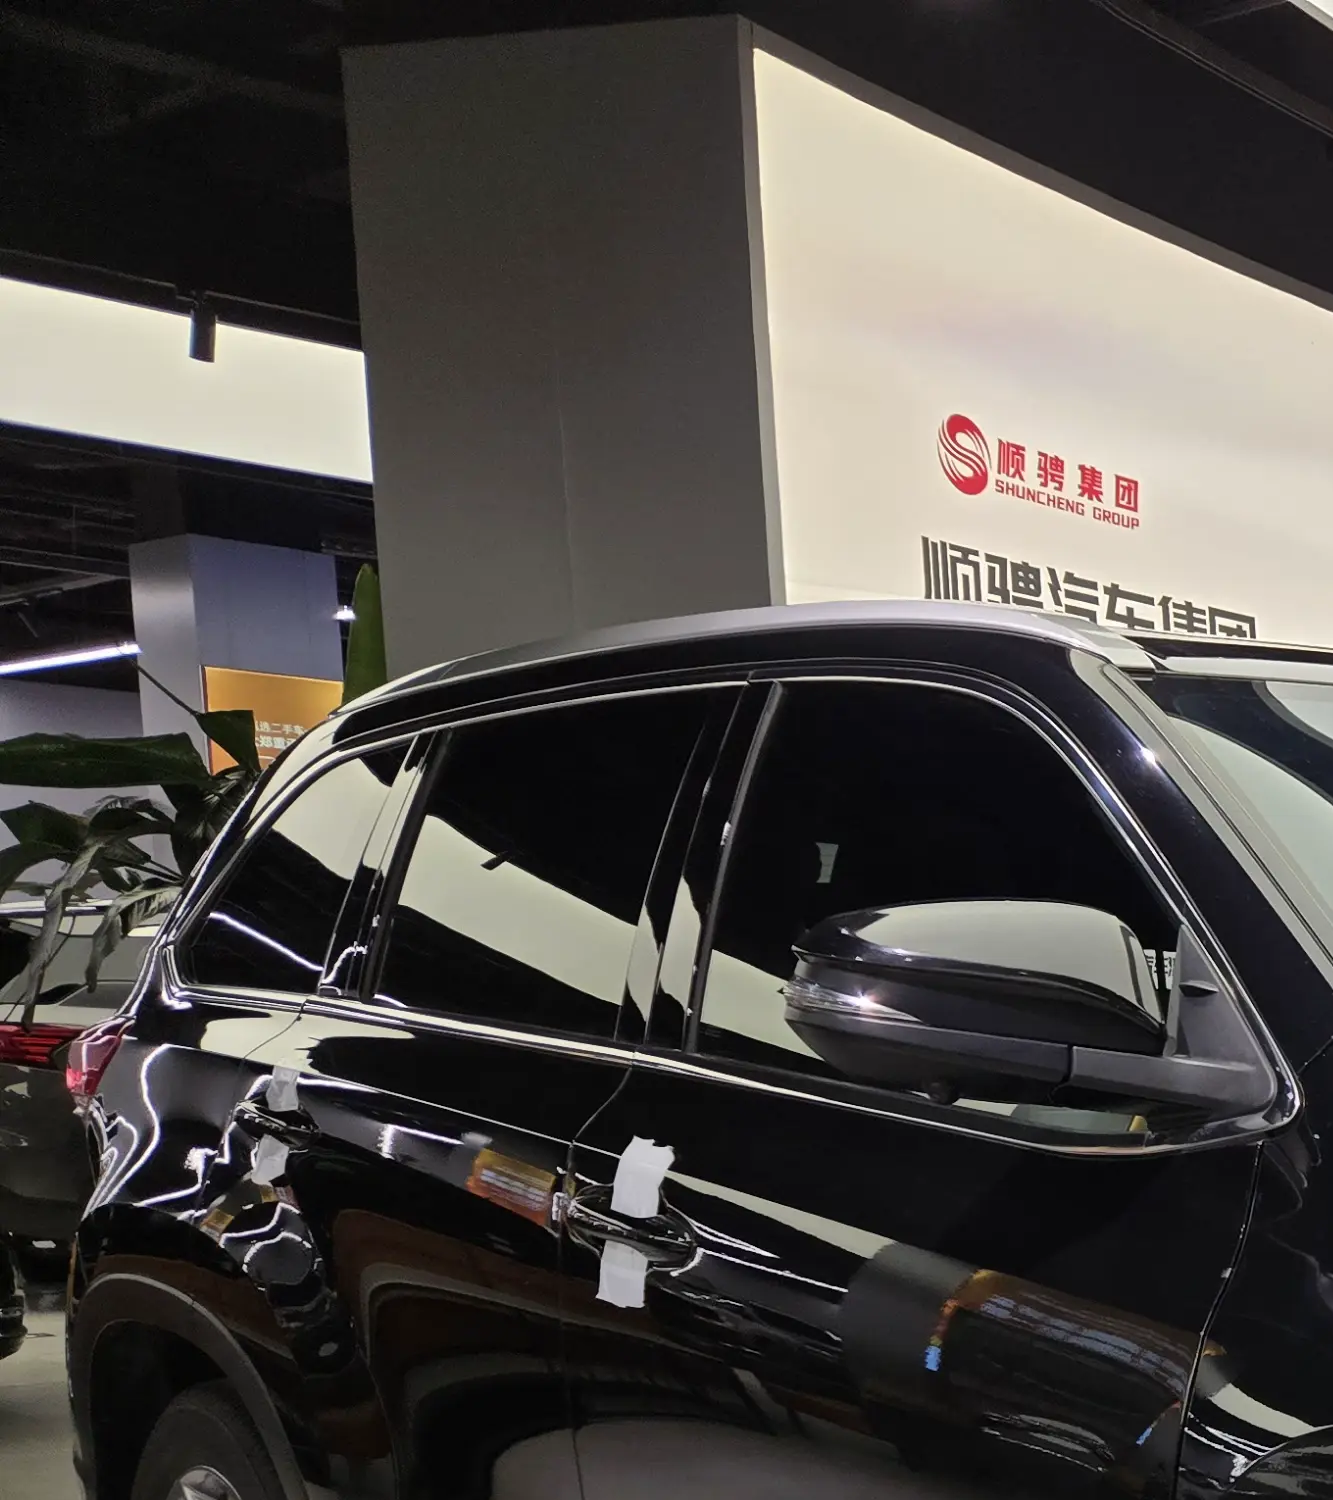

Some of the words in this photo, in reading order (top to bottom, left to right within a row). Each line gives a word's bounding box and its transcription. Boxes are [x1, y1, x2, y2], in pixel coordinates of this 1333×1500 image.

[995, 479, 1085, 517] SHUNCHENG
[1092, 506, 1140, 530] GROUP
[997, 437, 1139, 513] 顺骋集团
